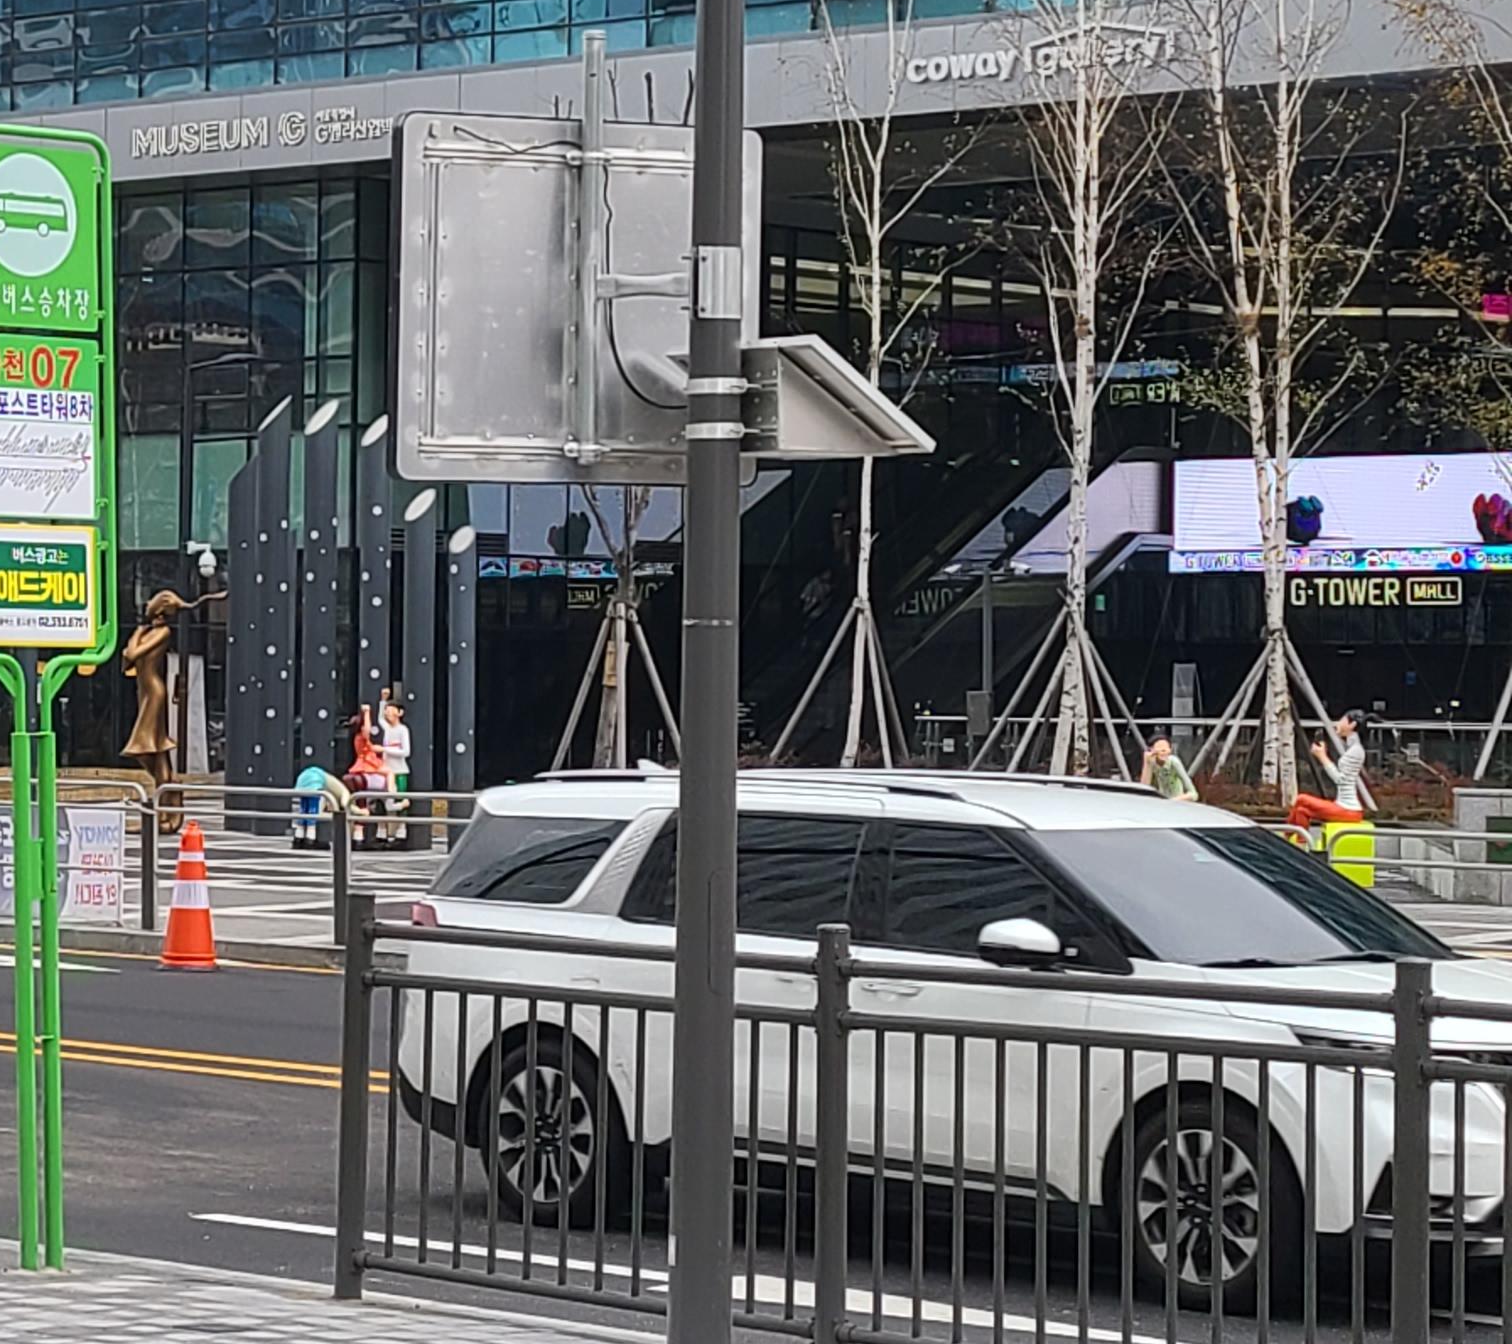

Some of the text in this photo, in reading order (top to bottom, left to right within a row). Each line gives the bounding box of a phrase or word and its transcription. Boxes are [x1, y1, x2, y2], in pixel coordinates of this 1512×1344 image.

[906, 47, 1016, 83] coway
[131, 116, 270, 158] MUSEUM
[12, 546, 70, 565] 버스광고는
[1413, 584, 1457, 600] MALL
